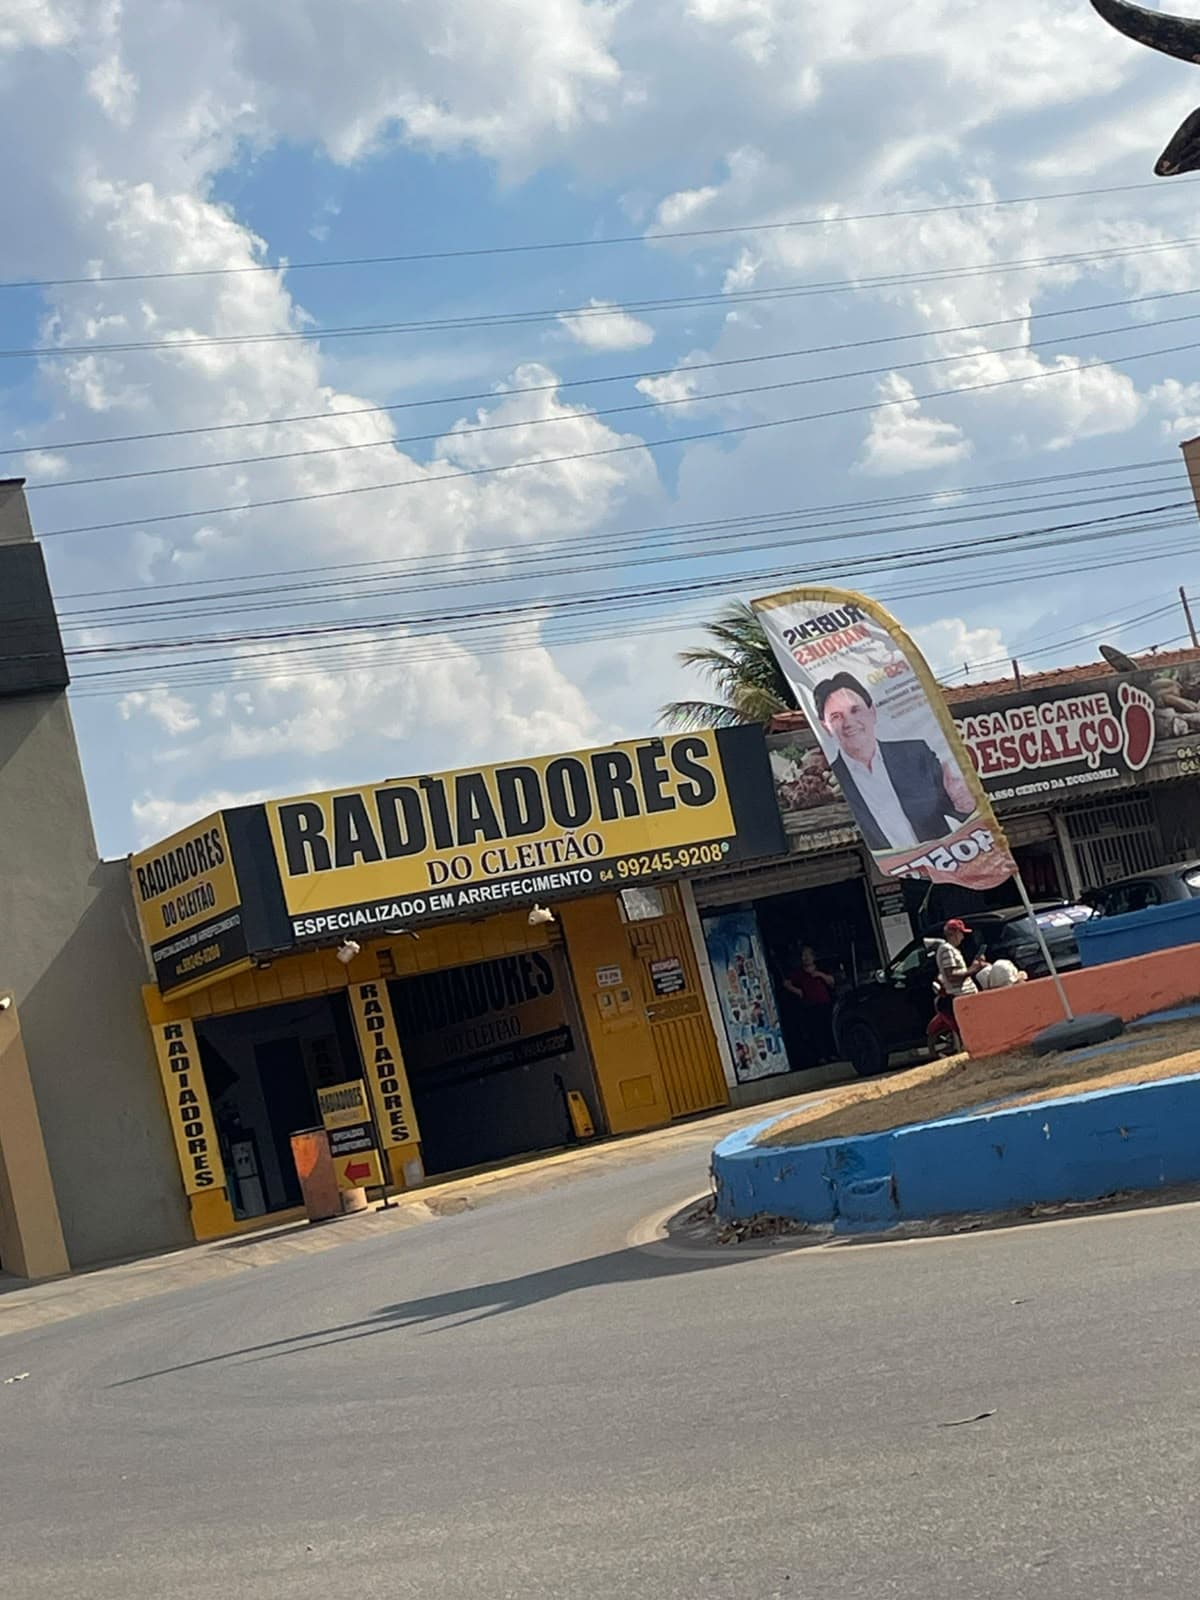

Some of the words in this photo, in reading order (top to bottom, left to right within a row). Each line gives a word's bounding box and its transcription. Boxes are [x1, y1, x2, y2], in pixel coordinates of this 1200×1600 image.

[1009, 710, 1035, 731] DE
[1041, 697, 1108, 724] CARNE
[278, 737, 716, 876] RADIADORES
[1050, 779, 1065, 790] DA
[137, 828, 224, 901] RADIADORES
[427, 856, 472, 885] DO
[480, 831, 604, 874] CLEITÃO
[599, 869, 614, 882] 64
[617, 843, 722, 878] 99245-9208
[161, 904, 177, 928] DO
[177, 881, 215, 921] CLEITÃO
[292, 897, 425, 937] ESPECIALIZADO
[430, 893, 454, 912] EM
[458, 868, 593, 907] ARREFECIMENTO
[360, 984, 409, 1142] RADIADORES
[164, 1024, 214, 1187] RADIADORES
